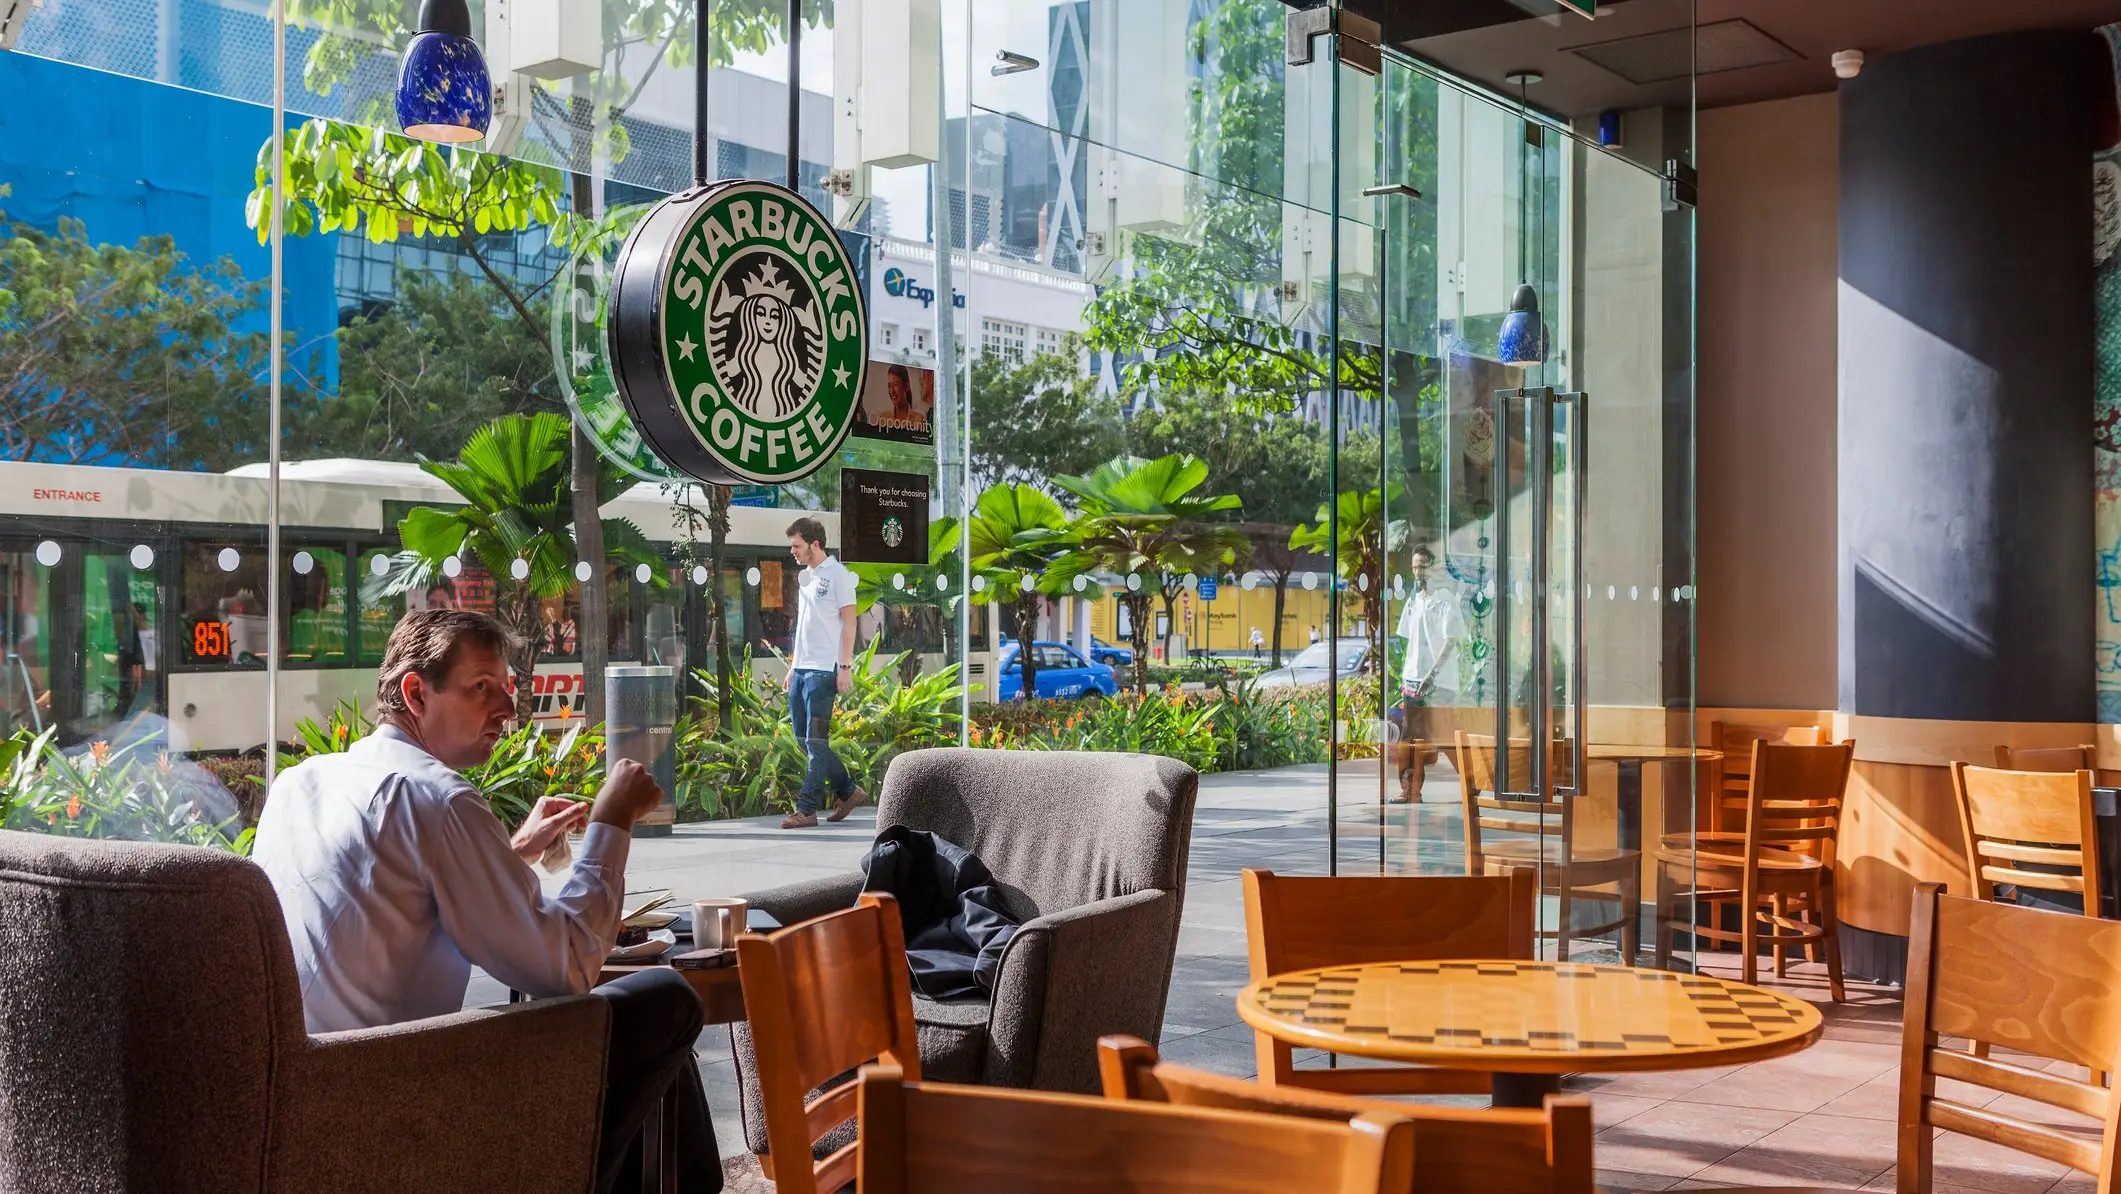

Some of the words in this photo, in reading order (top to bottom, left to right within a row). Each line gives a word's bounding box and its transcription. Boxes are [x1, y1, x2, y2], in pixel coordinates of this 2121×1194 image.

[674, 200, 857, 342] STARBUCKS
[907, 278, 966, 309] Expia
[691, 382, 834, 468] COFFEE
[868, 411, 933, 438] Opportunity
[33, 488, 101, 502] ENTRANCE
[860, 485, 878, 494] Thank
[880, 488, 891, 497] you
[892, 487, 900, 496] for
[901, 489, 927, 500] choosing
[878, 498, 909, 508] Starbucks.
[194, 622, 229, 656] 851
